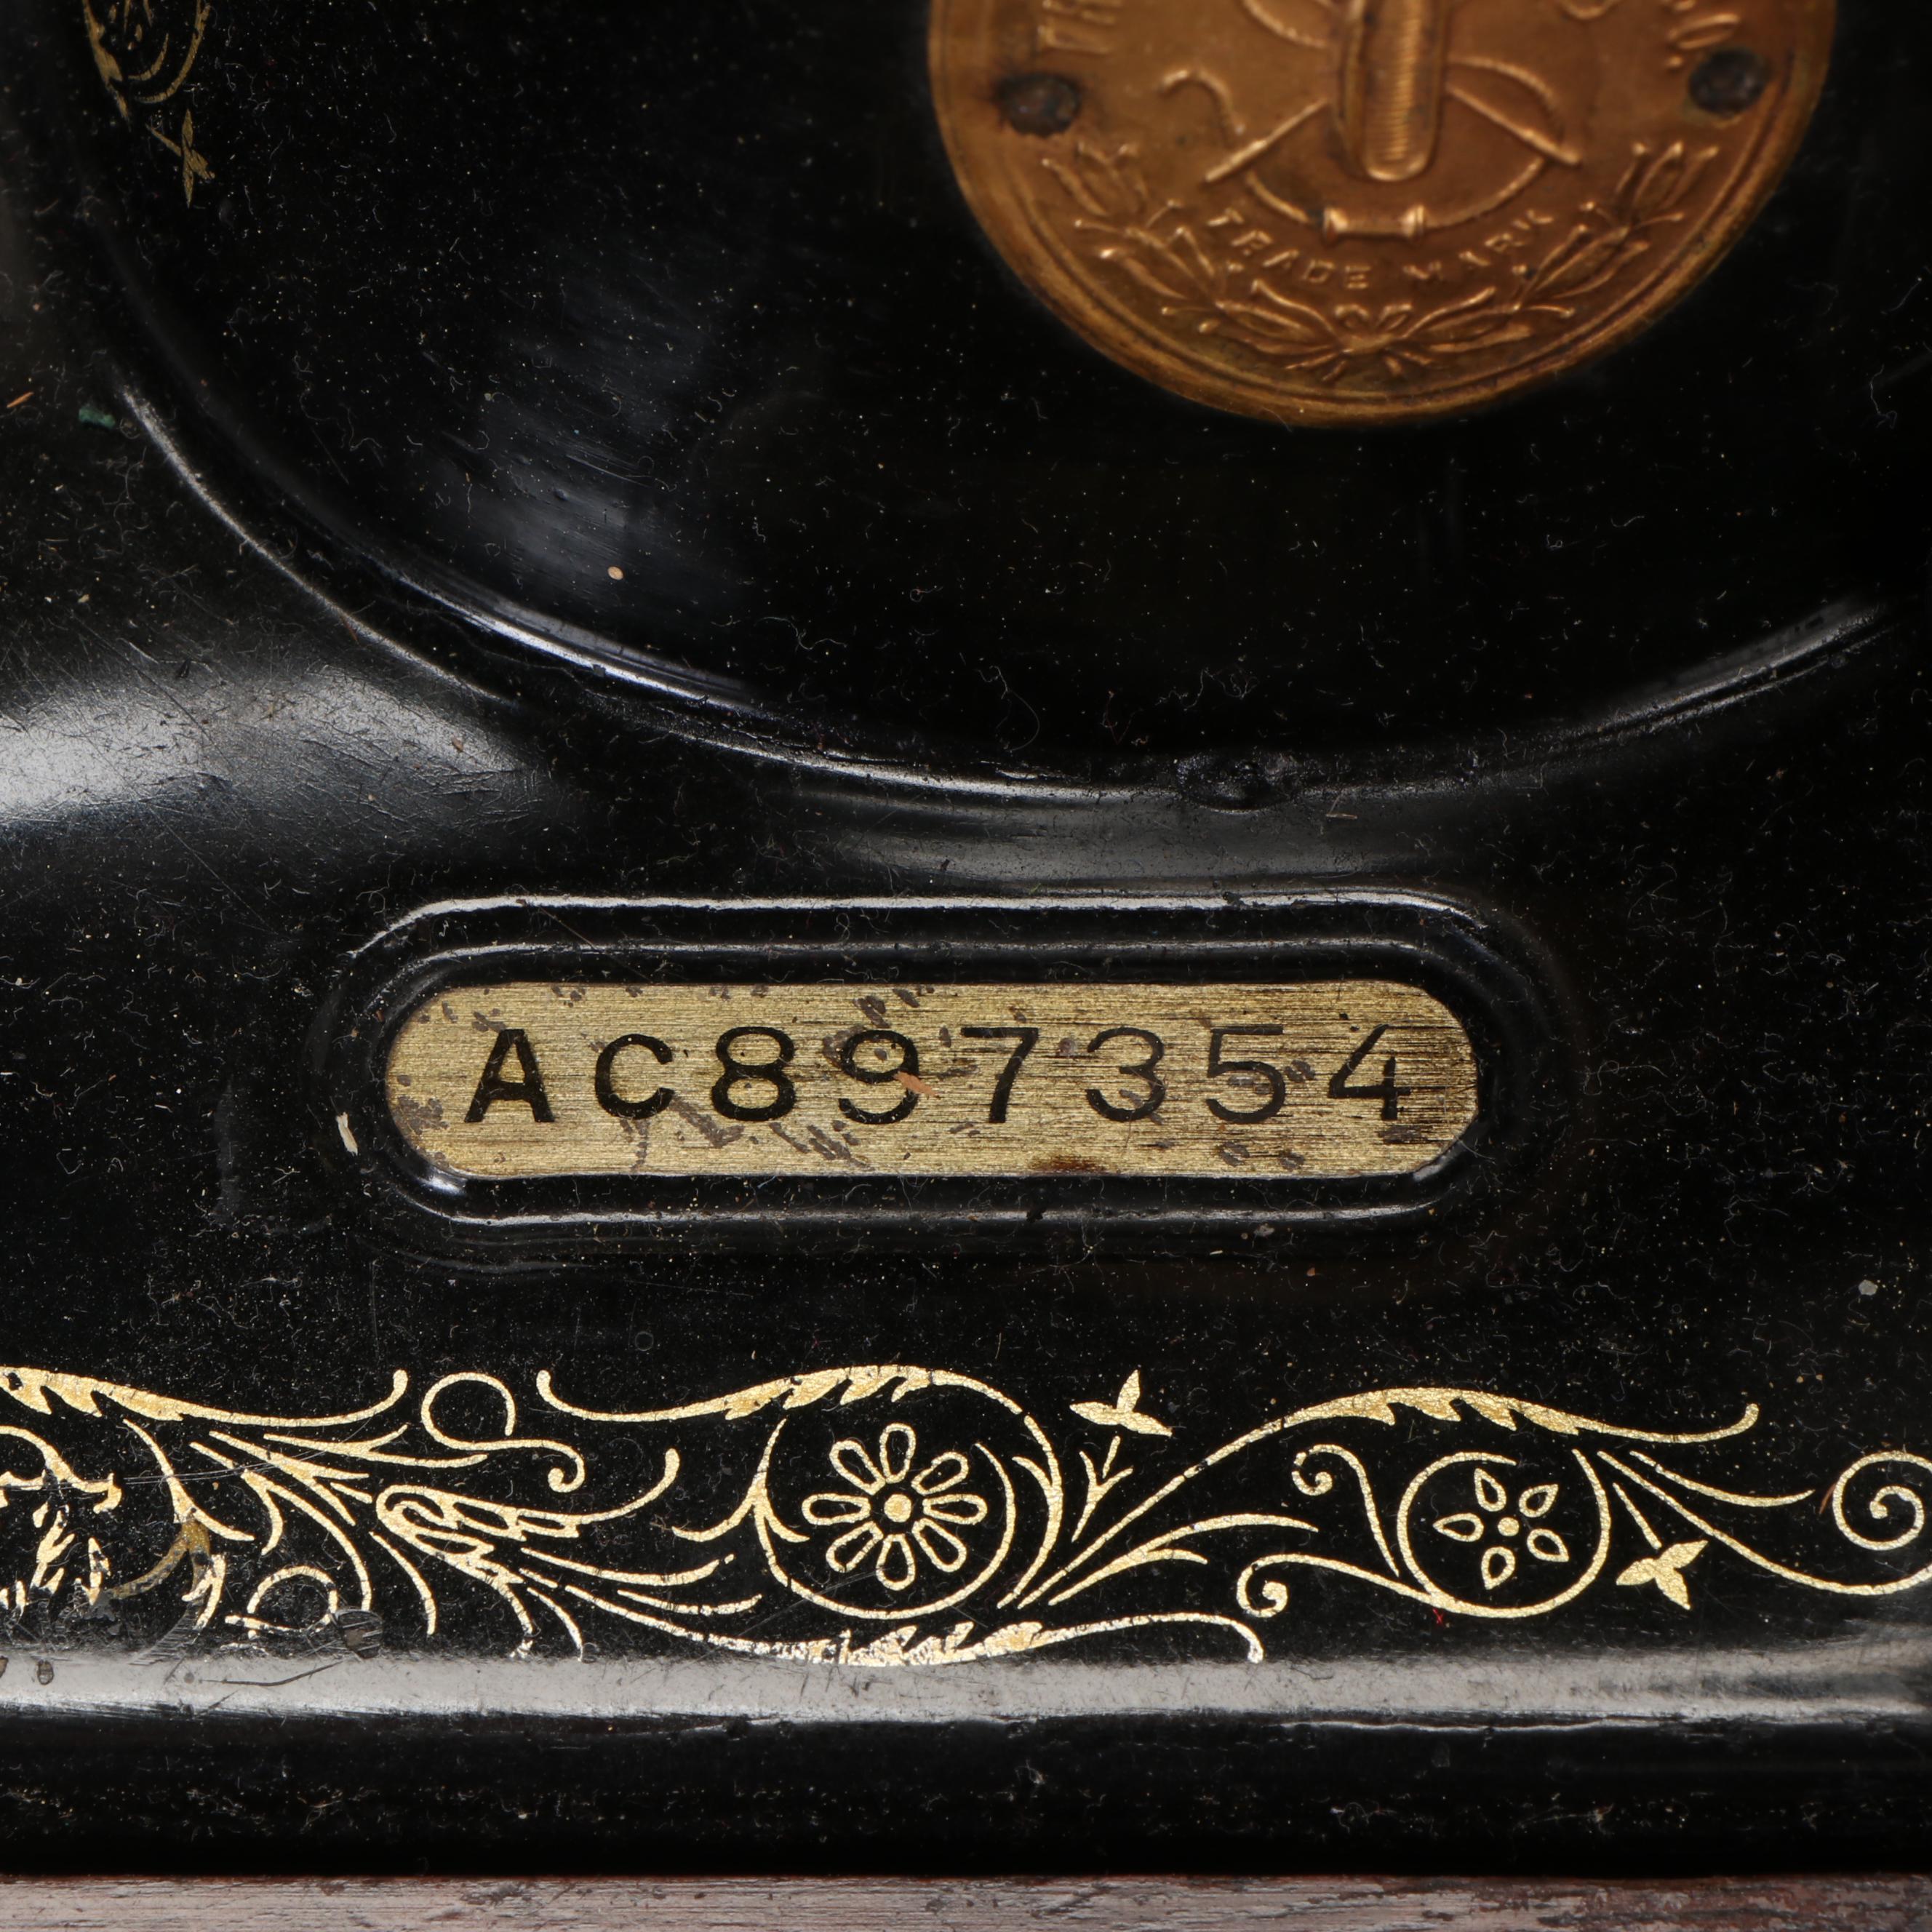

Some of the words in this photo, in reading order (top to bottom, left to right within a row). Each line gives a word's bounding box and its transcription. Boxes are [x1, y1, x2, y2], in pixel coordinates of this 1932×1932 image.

[1208, 208, 1372, 290] TRADE
[1403, 209, 1554, 281] MARK
[463, 1024, 1412, 1125] AC897354
